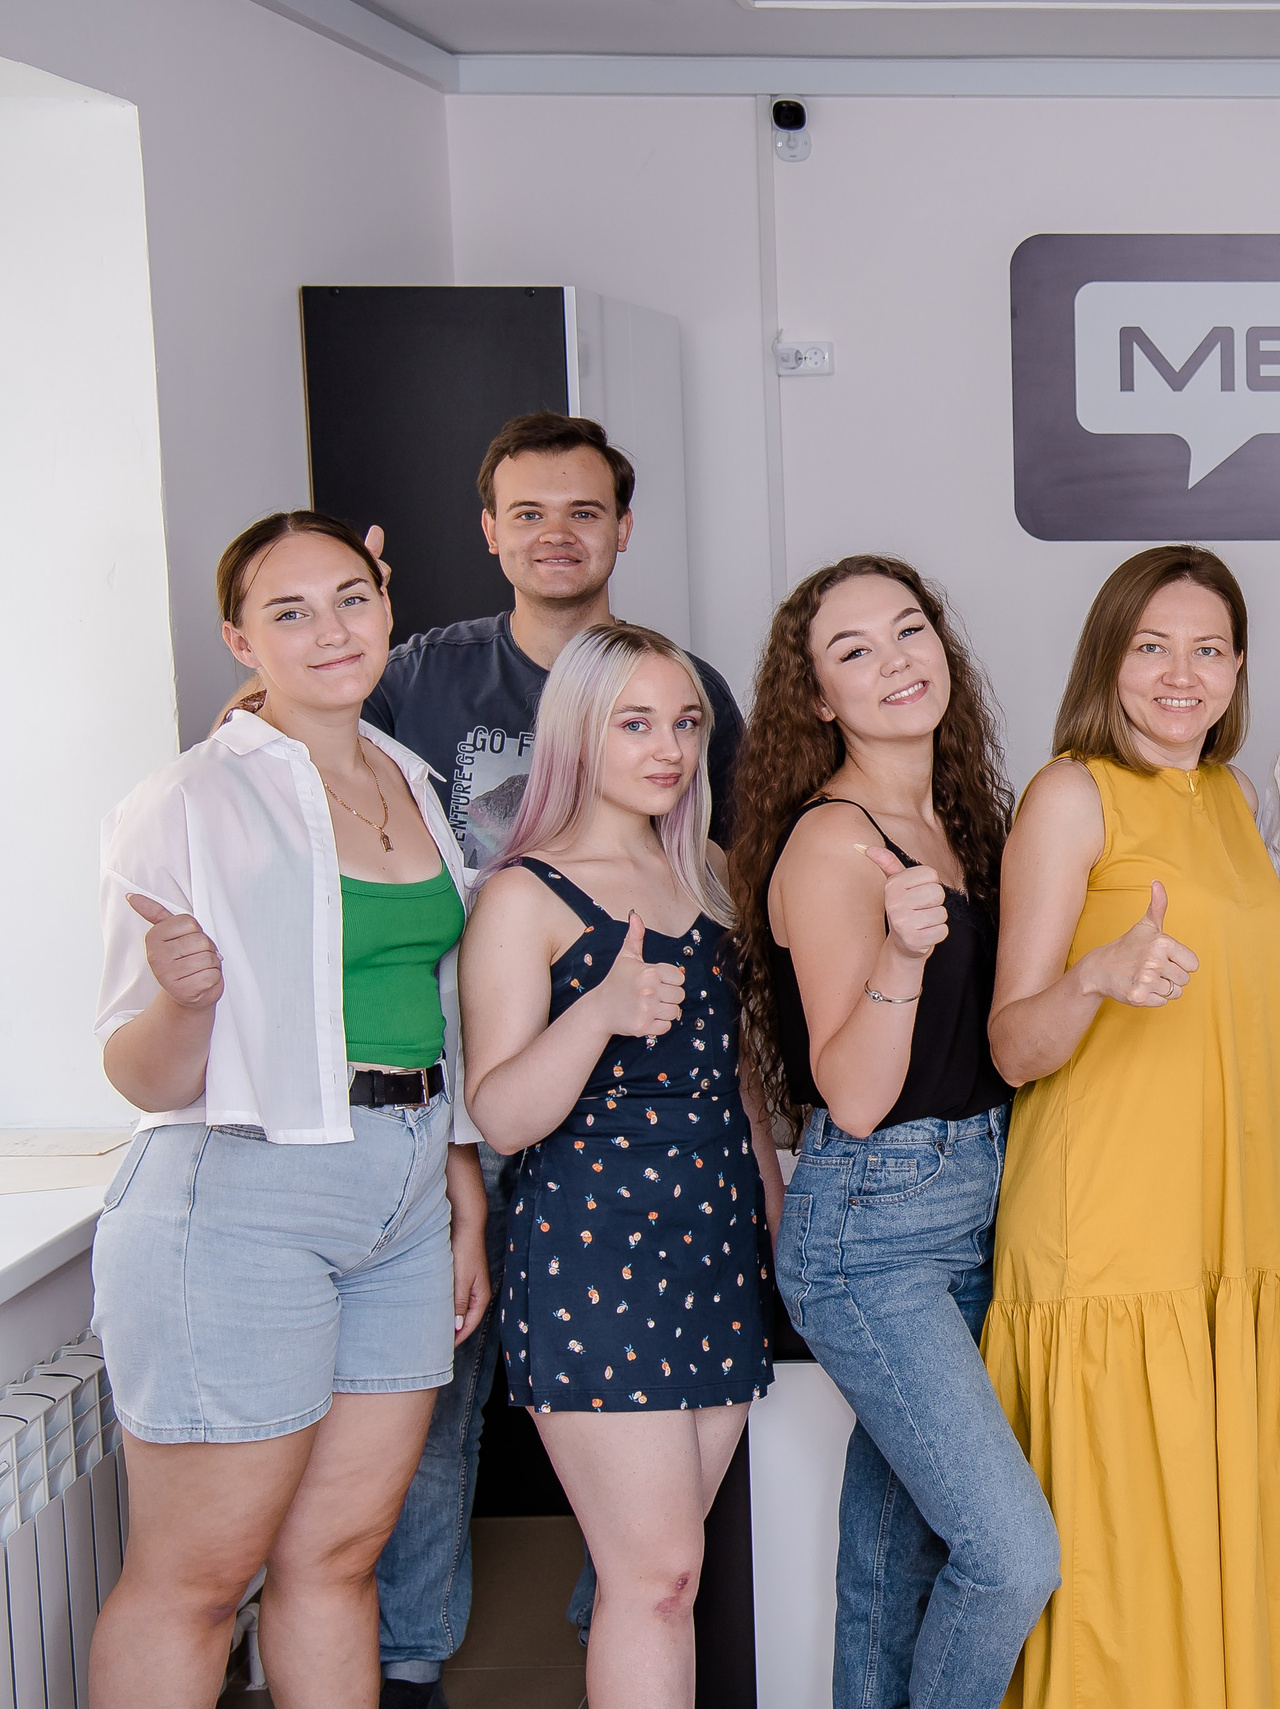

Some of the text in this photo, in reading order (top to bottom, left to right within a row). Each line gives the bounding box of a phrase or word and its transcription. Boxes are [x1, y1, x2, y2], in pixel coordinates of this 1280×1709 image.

[472, 726, 507, 755] GO
[449, 741, 475, 851] ENTURE GO
